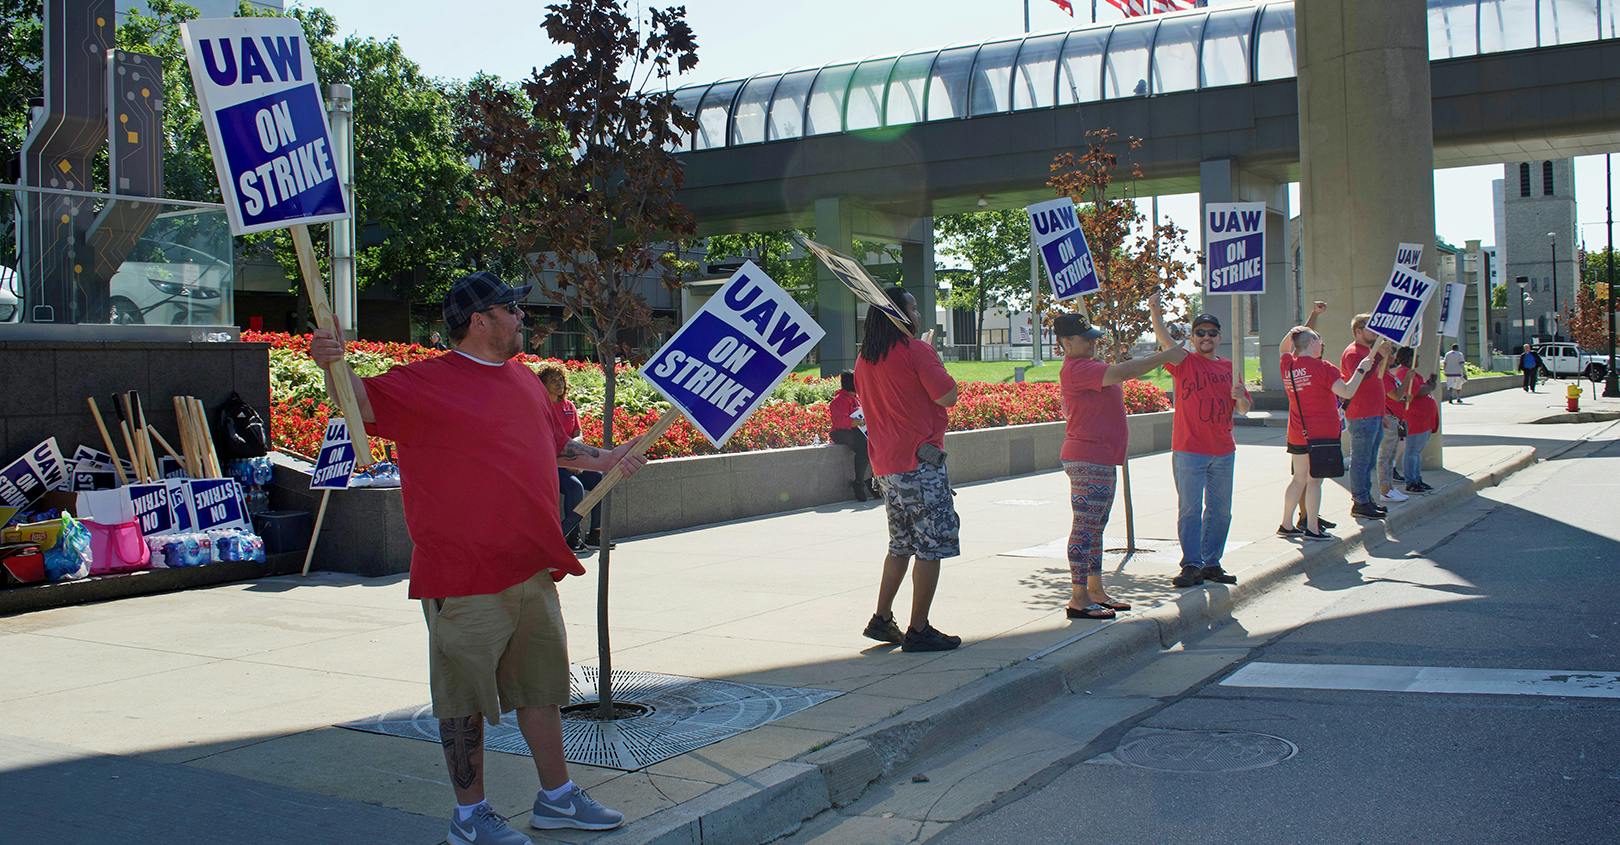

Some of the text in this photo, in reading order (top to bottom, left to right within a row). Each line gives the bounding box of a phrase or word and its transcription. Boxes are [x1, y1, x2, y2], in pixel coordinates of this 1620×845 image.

[199, 36, 303, 87] UAW
[255, 100, 297, 154] ON
[239, 137, 334, 218] STRIKE
[1032, 205, 1075, 235] UAW
[1210, 211, 1262, 233] UAW
[1058, 237, 1076, 264] ON
[1226, 239, 1246, 263] ON
[1397, 248, 1421, 265] UAW
[1054, 252, 1093, 294] STRIKE
[1211, 256, 1261, 289] STRIKE
[1390, 270, 1429, 298] UAW
[724, 273, 811, 358] UAW
[1388, 298, 1408, 314] ON
[1370, 312, 1411, 331] STRIKE
[707, 335, 757, 375] ON
[654, 349, 755, 418] STRIKE
[33, 442, 62, 486] UAW
[328, 446, 345, 464] ON
[16, 472, 39, 493] ON
[313, 460, 352, 485] STRIKE
[131, 488, 166, 515] STRIK
[195, 482, 235, 510] STRIKE
[142, 511, 159, 533] ON
[210, 503, 227, 523] ON
